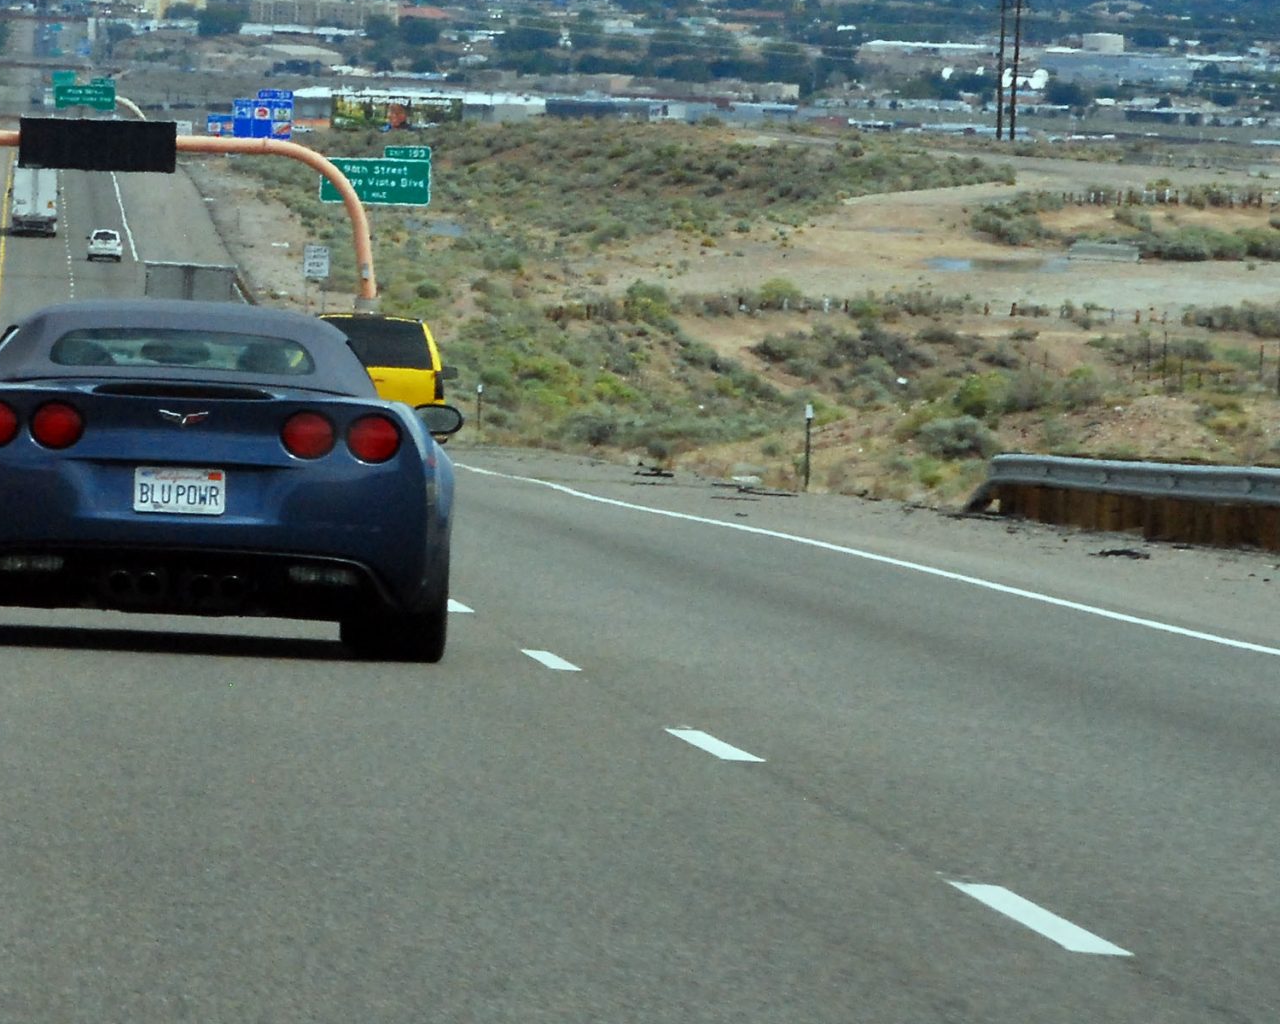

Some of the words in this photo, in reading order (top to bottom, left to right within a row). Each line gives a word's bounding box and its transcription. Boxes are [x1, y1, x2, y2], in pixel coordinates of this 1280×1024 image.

[373, 165, 409, 176] Street
[368, 178, 396, 188] Vista
[400, 178, 424, 188] Blvd
